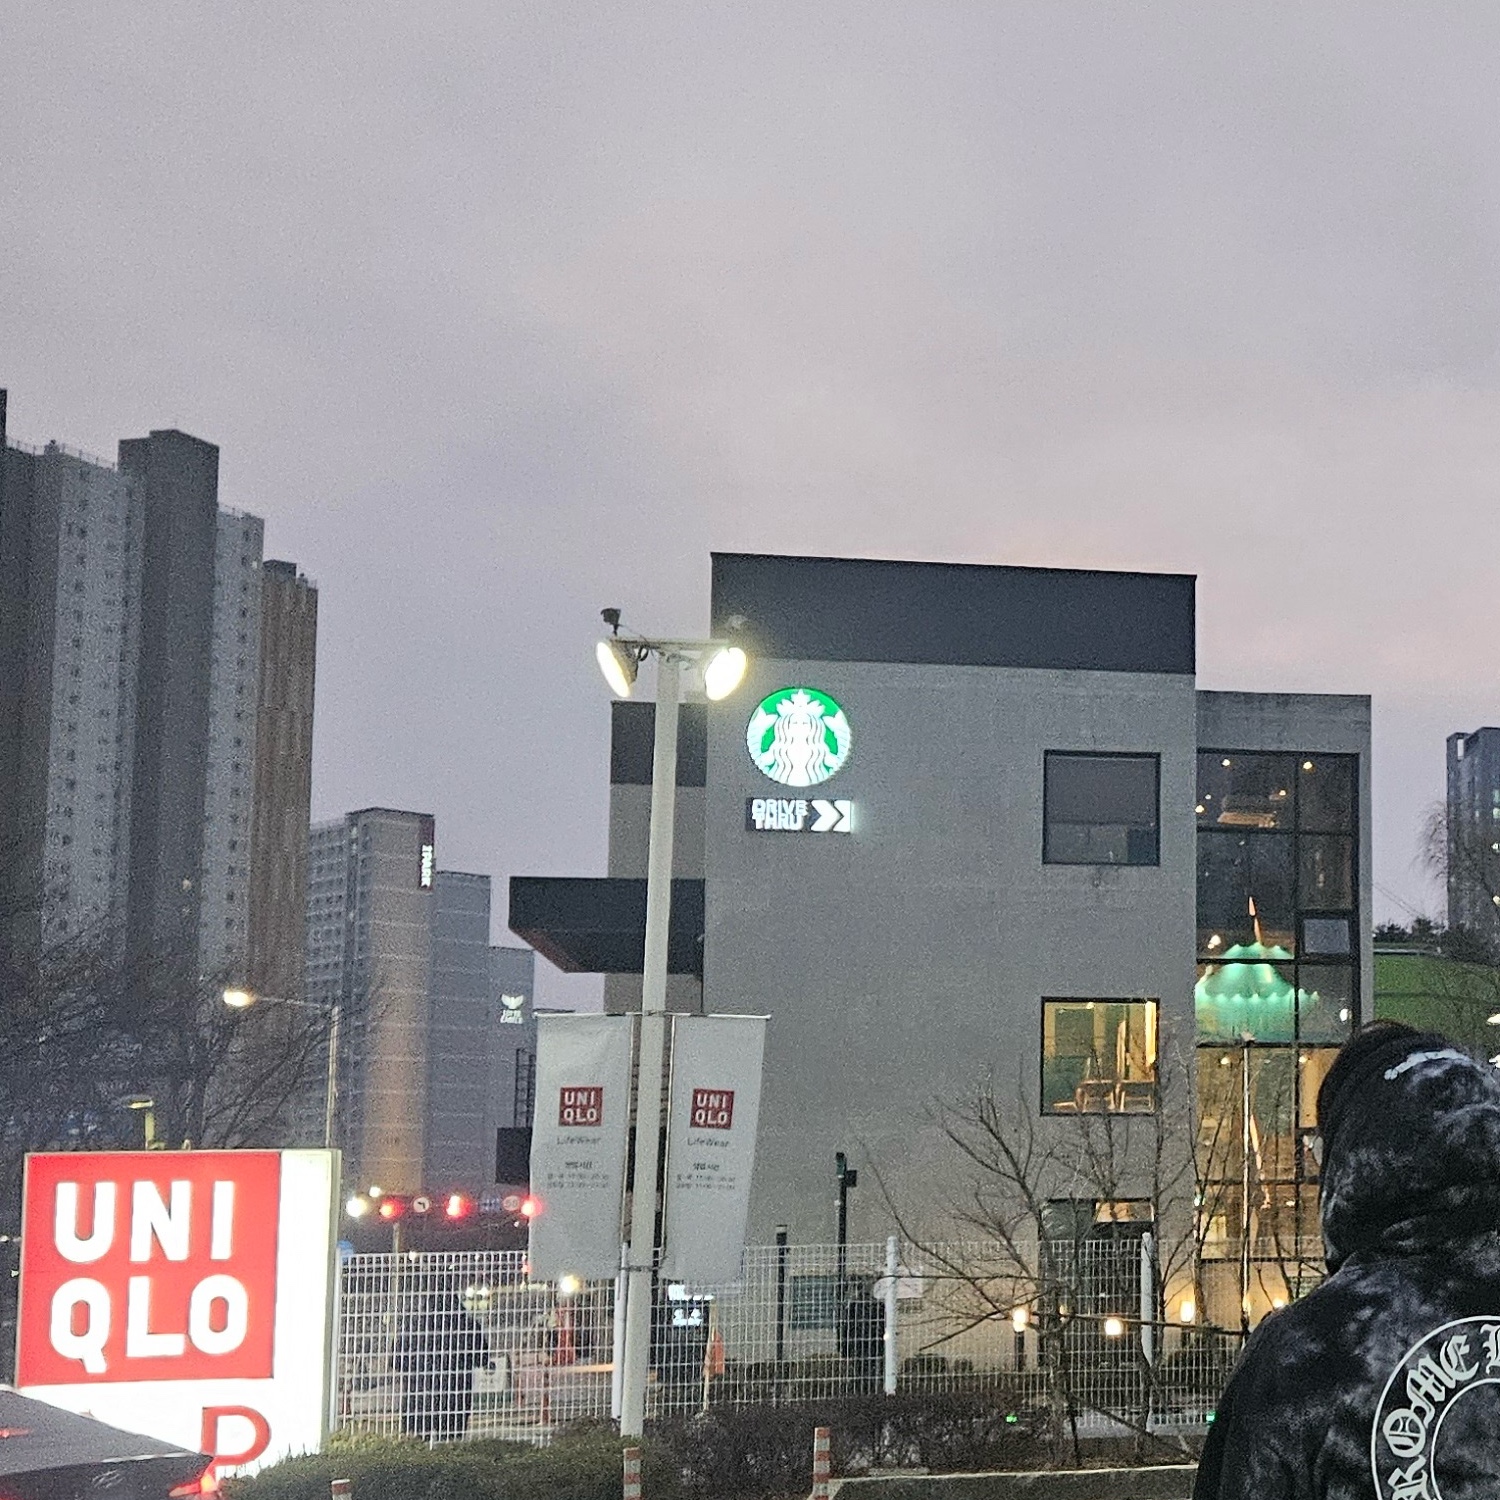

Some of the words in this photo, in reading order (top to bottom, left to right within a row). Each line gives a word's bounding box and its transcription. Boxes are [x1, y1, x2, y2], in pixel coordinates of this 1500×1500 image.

[752, 799, 809, 816] DRIVE
[564, 1091, 595, 1106] UNI
[697, 1093, 727, 1108] UNI
[563, 1108, 597, 1124] QLO
[695, 1109, 728, 1126] QLO
[55, 1180, 235, 1264] UNI
[50, 1274, 249, 1374] QLO
